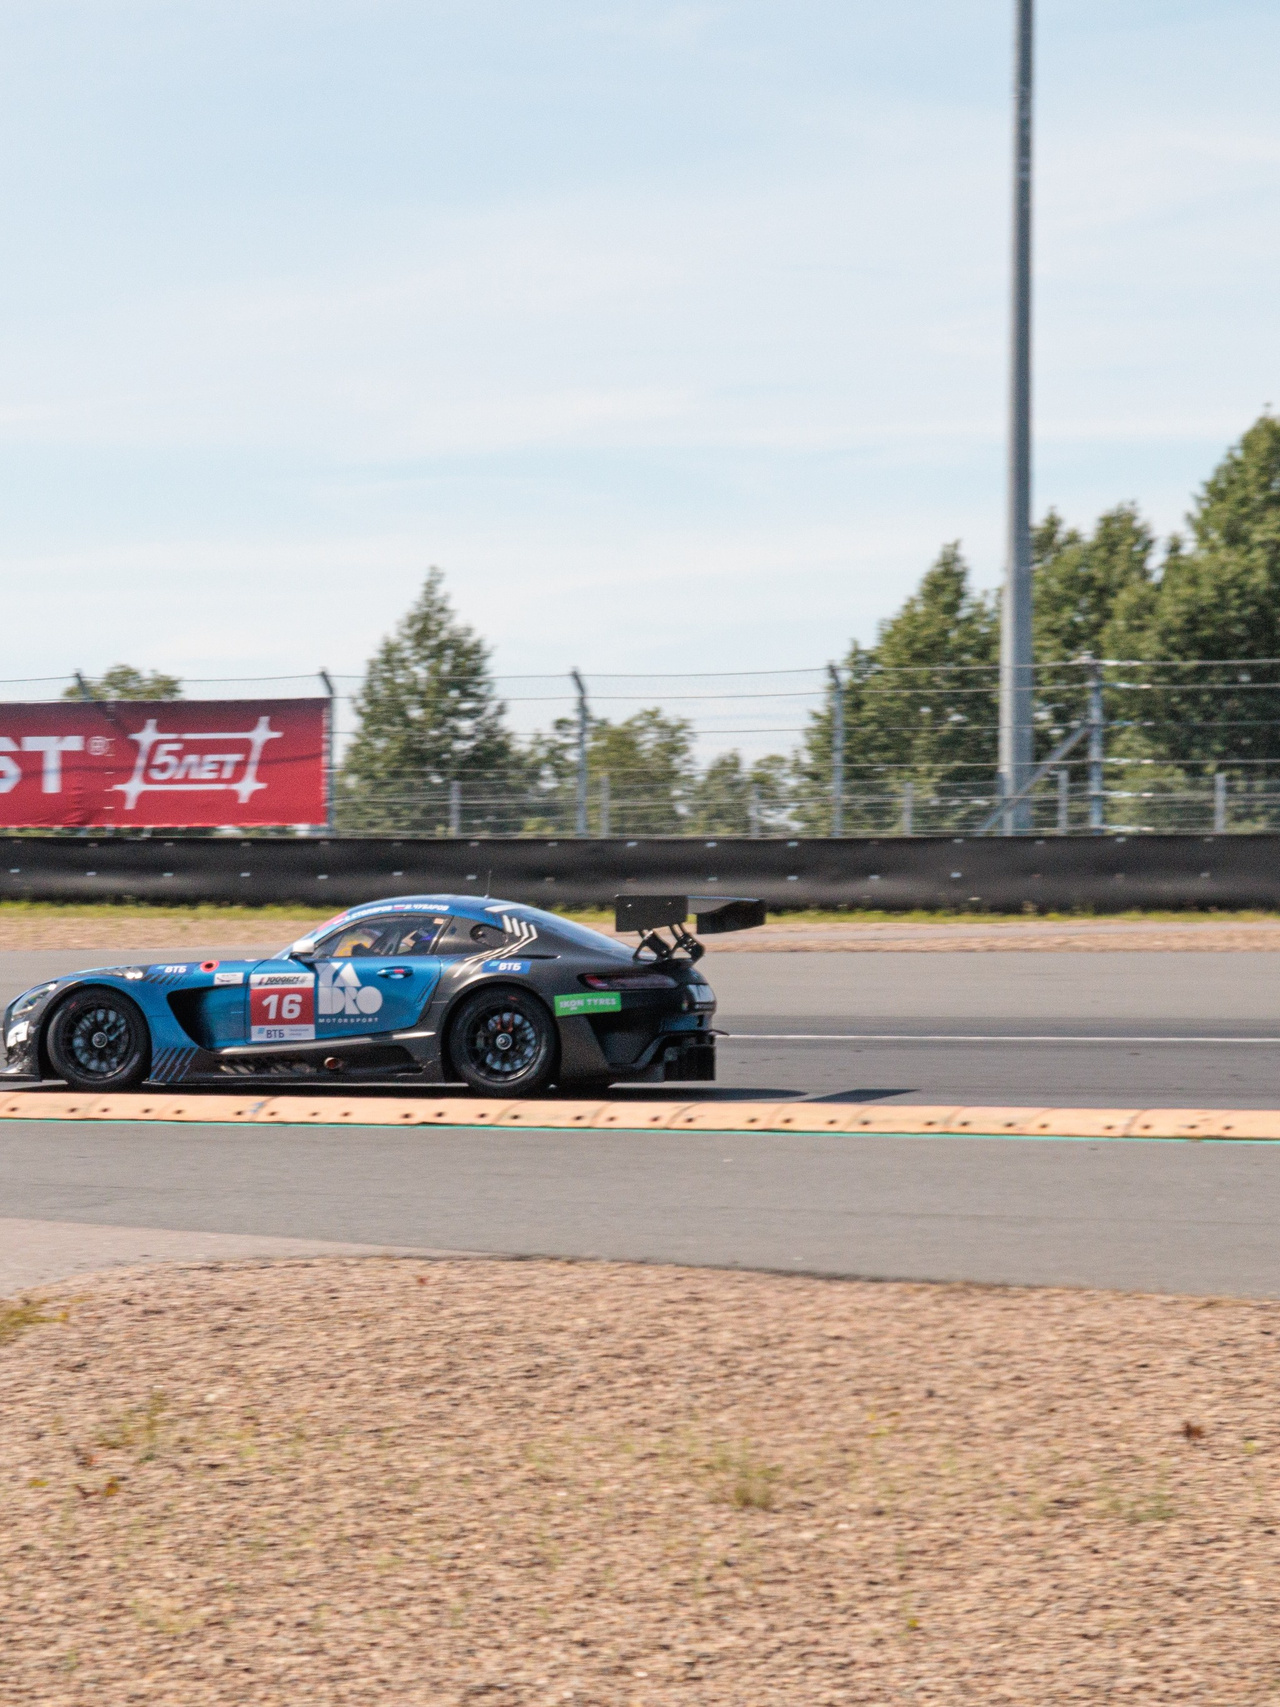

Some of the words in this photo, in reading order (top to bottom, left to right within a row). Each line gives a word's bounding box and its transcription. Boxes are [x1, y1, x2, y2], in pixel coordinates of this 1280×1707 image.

[164, 965, 187, 974] ВТБ
[498, 961, 522, 971] ВТБ
[261, 993, 303, 1020] 16
[586, 998, 616, 1006] TYRES
[266, 1029, 284, 1038] ВТБ
